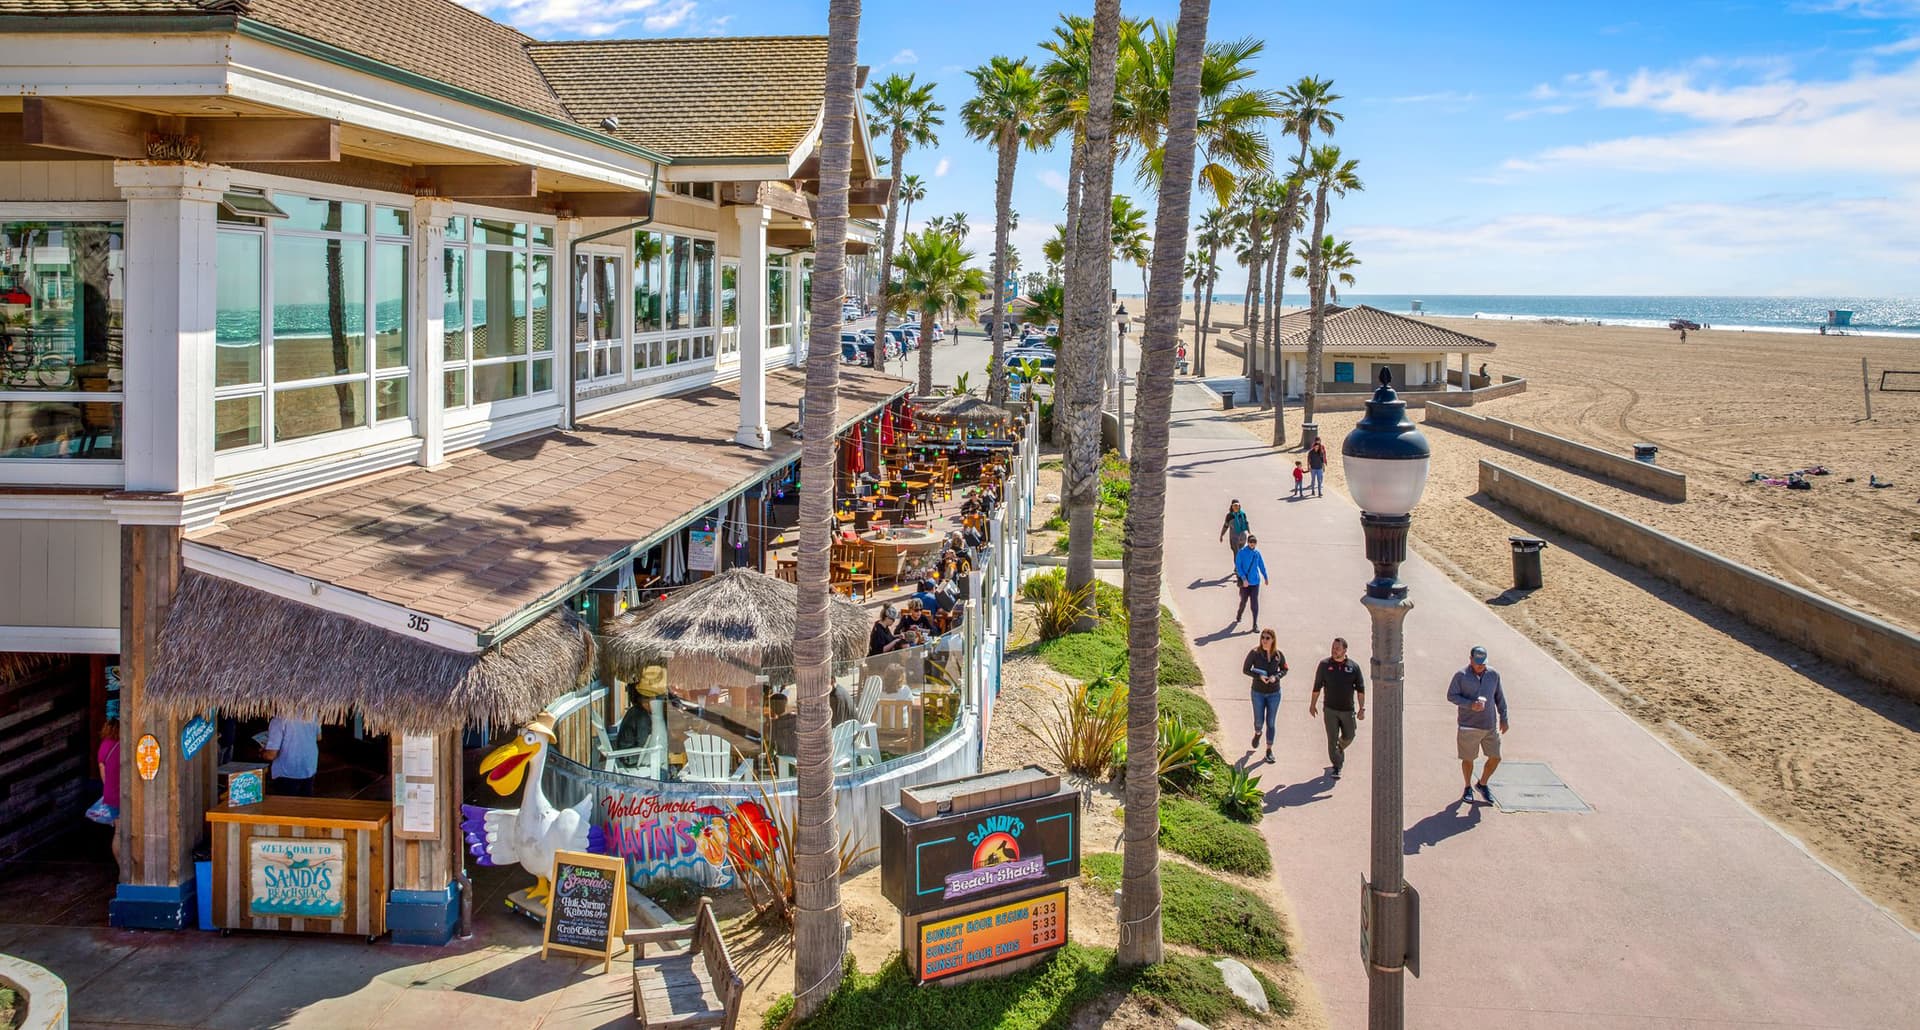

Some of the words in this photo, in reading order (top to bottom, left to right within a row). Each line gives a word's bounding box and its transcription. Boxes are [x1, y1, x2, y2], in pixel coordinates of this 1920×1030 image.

[408, 613, 430, 632] 315
[601, 793, 643, 820] World
[641, 794, 696, 819] Famous
[967, 815, 1025, 847] SANDY'S
[261, 844, 316, 855] WELCOME
[317, 846, 331, 855] TO
[264, 863, 333, 891] SANDY'S
[564, 873, 608, 890] Specials
[575, 867, 600, 879] Shack
[952, 872, 994, 892] Beach
[997, 862, 1040, 882] Shack
[926, 923, 964, 943] SUNSET
[966, 917, 993, 933] HOUR
[995, 907, 1029, 926] BEGINS
[1032, 902, 1057, 917] 4:33
[926, 939, 964, 959] SUNSET
[1032, 916, 1057, 931] 5:33
[926, 955, 964, 974] SUNSET
[967, 948, 993, 964] HOUR
[995, 939, 1020, 956] ENDS
[1032, 929, 1057, 945] 6:33
